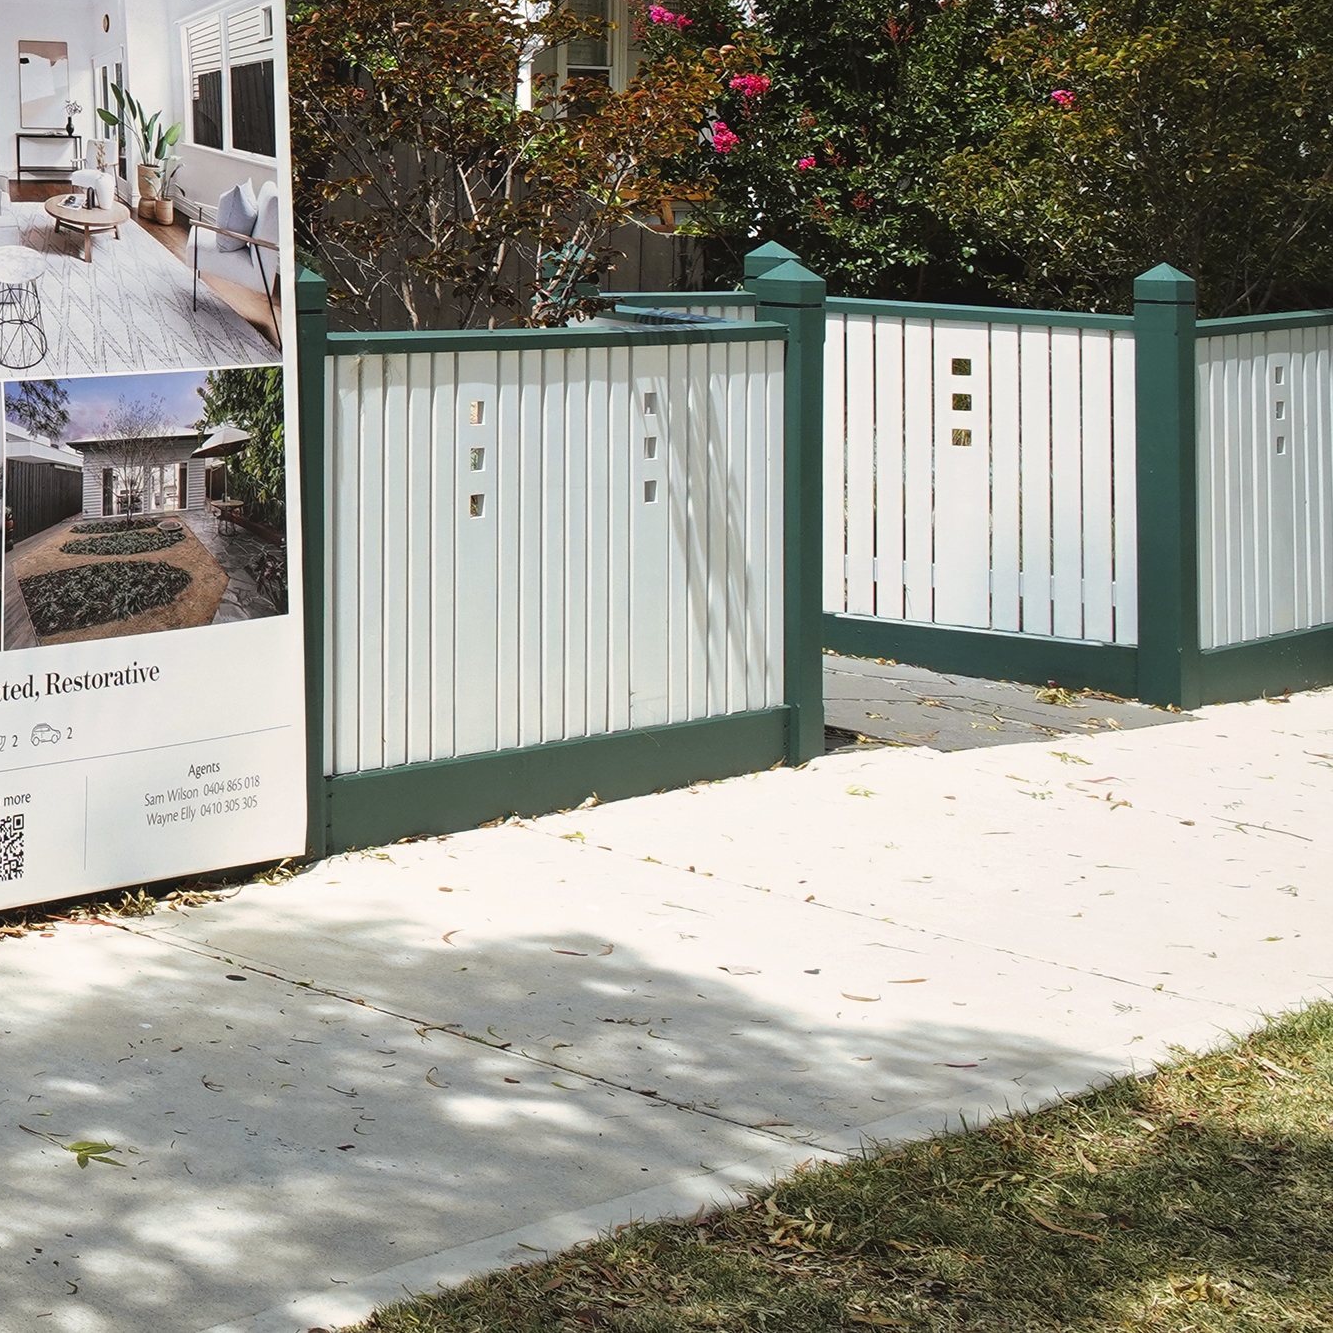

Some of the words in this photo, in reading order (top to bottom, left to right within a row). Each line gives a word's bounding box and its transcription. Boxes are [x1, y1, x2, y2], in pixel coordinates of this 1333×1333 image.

[45, 661, 161, 696] Restorative
[12, 735, 19, 748] 2
[66, 727, 73, 740] 2
[188, 762, 221, 779] Agents
[3, 793, 32, 808] more
[144, 793, 165, 807] Sam
[167, 787, 199, 803] Wilson
[203, 781, 225, 797] 0404
[226, 777, 243, 792] 865
[244, 775, 261, 789] 018
[146, 810, 179, 827] Wayne
[180, 806, 196, 822] Elly
[200, 801, 223, 817] 0410
[224, 798, 240, 813] 305
[242, 795, 258, 809] 305
